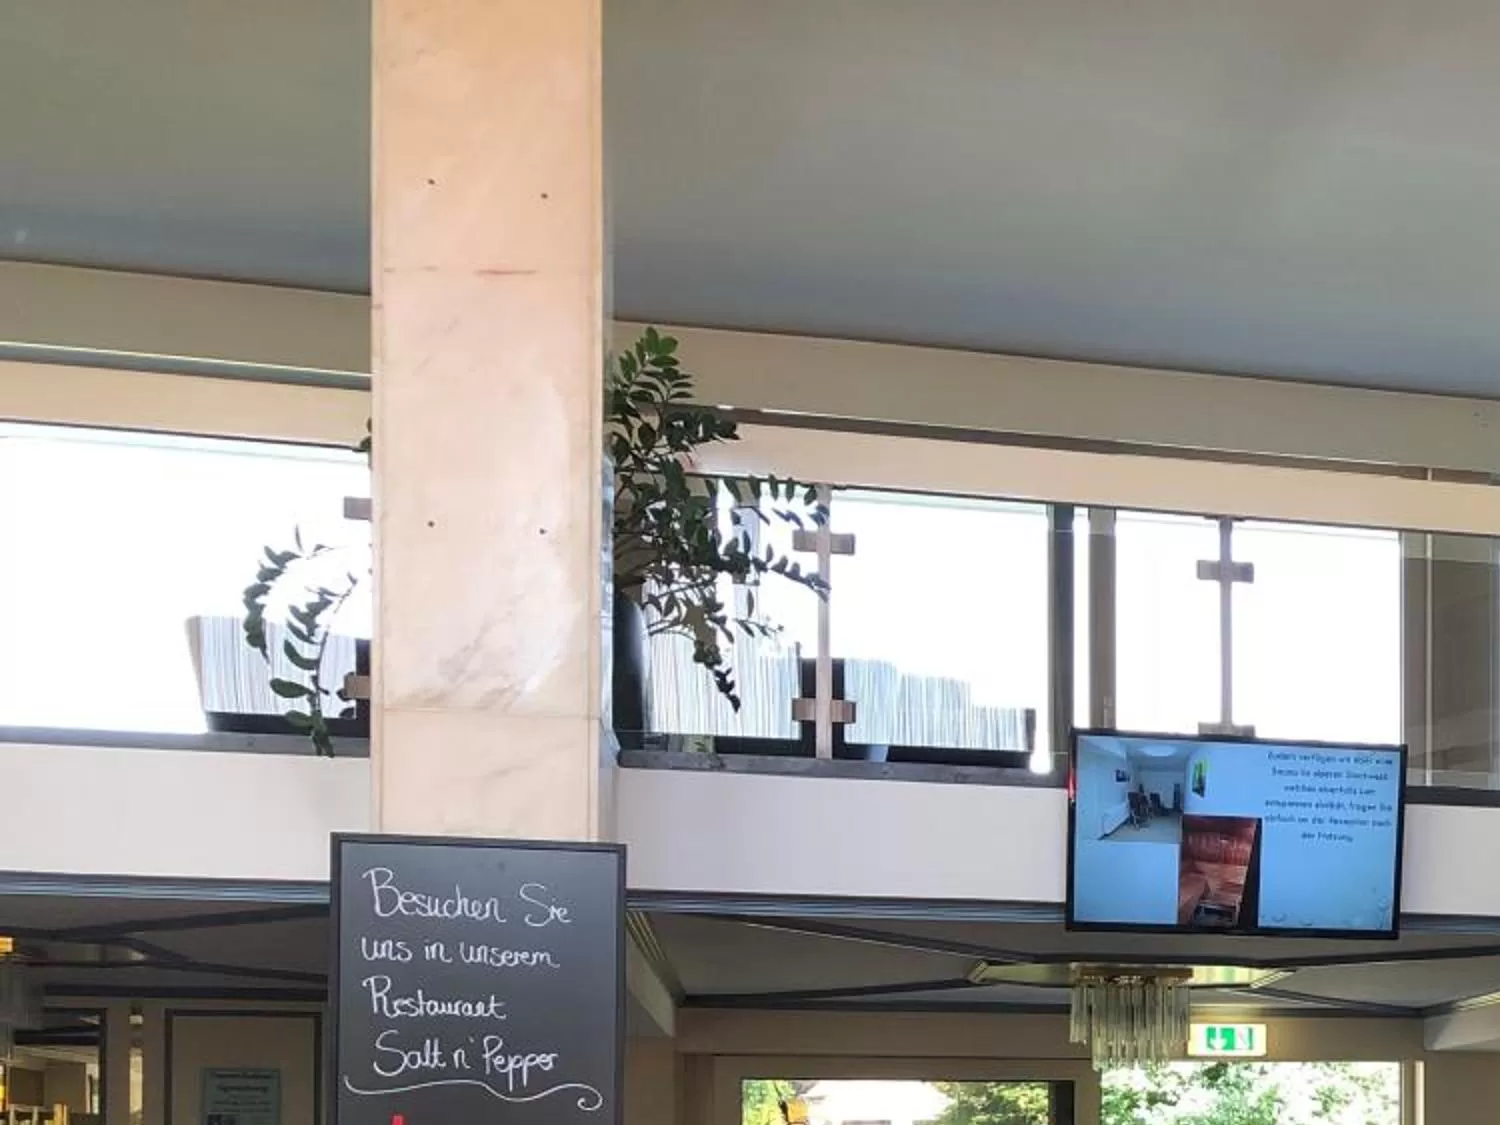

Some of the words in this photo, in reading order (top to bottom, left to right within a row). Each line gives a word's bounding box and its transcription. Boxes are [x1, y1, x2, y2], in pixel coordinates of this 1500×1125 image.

[361, 867, 507, 923] Besuchen
[519, 882, 572, 927] Sie
[361, 936, 413, 963] uns
[424, 940, 453, 964] in
[459, 941, 561, 969] unserem
[362, 975, 507, 1019] Restaurant
[373, 1029, 447, 1077] Salt
[482, 1035, 559, 1092] Pepper
